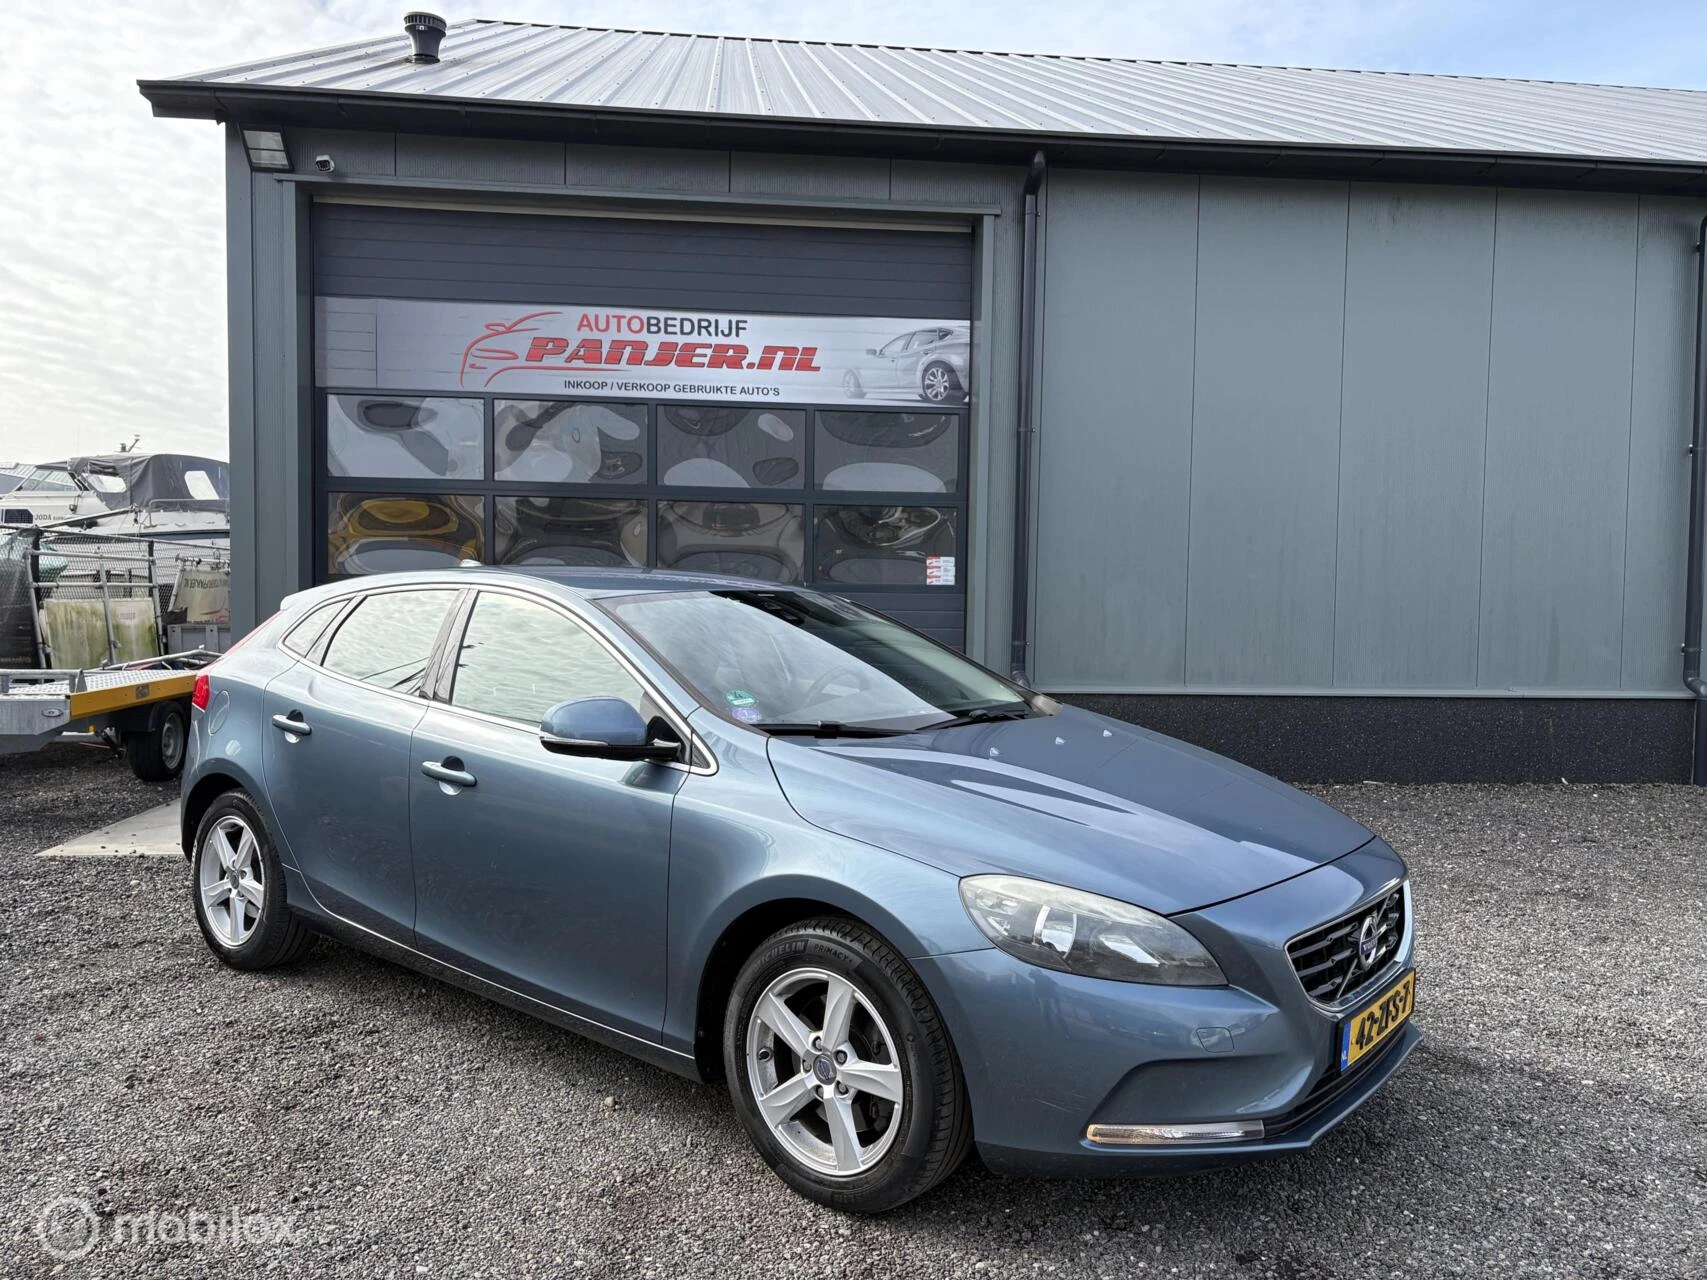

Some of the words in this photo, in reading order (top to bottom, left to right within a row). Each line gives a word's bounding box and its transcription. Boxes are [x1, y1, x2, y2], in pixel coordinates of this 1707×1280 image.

[577, 313, 748, 338] AUTOBEDRIJF
[564, 379, 608, 390] INKOOP
[616, 382, 671, 393] VERKOOP
[673, 384, 737, 395] GEBRUIKTE
[739, 386, 781, 397] AUTO'S
